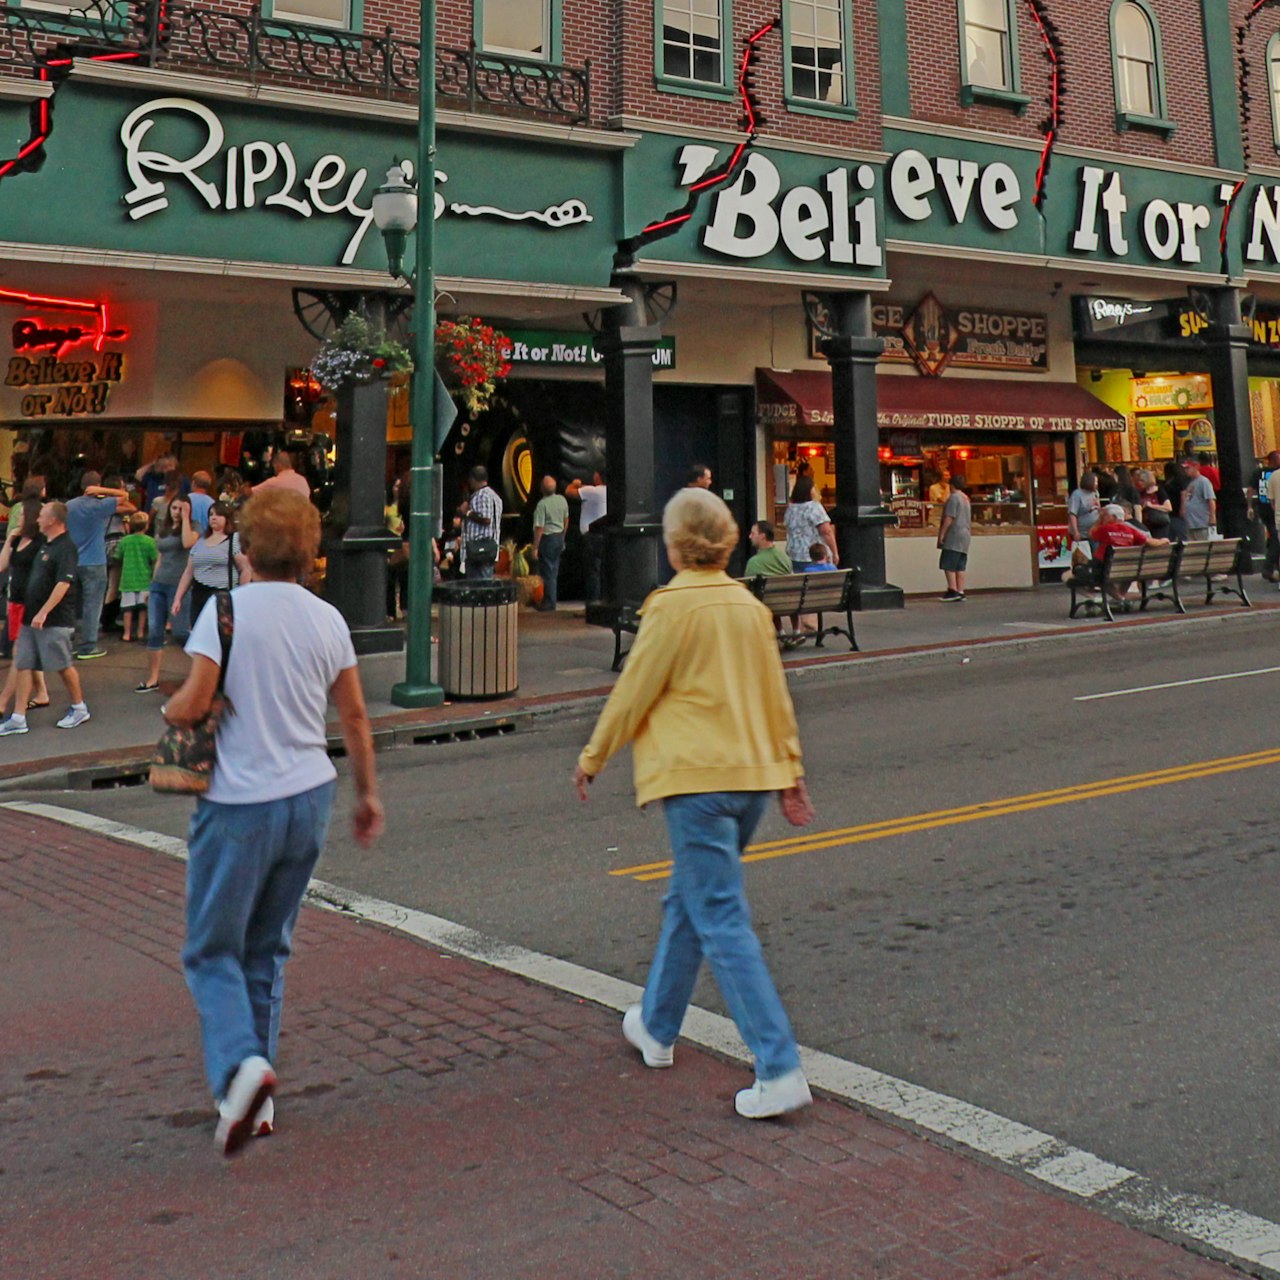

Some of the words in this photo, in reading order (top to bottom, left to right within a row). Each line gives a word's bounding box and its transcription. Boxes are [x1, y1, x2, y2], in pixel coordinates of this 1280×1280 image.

[677, 144, 1022, 267] Believe
[1072, 165, 1129, 257] It
[1142, 198, 1211, 264] or
[958, 311, 1046, 338] SHOPPE
[512, 342, 529, 360] It
[530, 346, 550, 362] or
[550, 343, 588, 363] Not!
[5, 355, 97, 386] Believe
[96, 351, 124, 382] It
[22, 394, 52, 417] or
[53, 382, 110, 416] Not!
[927, 412, 971, 427] FUDGE
[973, 414, 1025, 429] SHOPPE
[1029, 416, 1046, 430] OF
[1049, 417, 1073, 431] THE
[1075, 418, 1126, 431] SMOKIES
